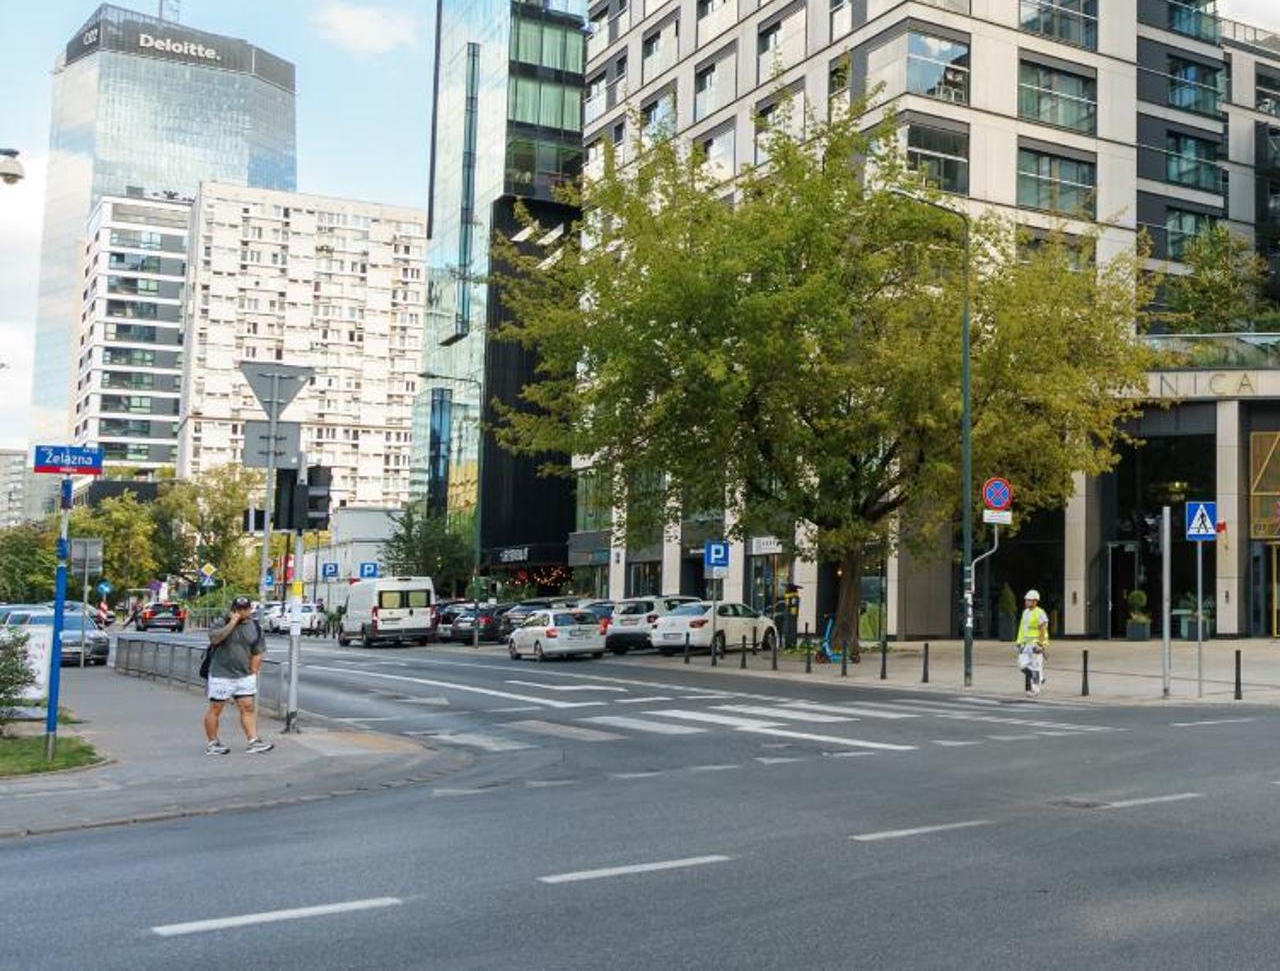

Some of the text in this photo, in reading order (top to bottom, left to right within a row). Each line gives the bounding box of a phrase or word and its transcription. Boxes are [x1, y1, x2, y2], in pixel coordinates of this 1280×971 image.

[139, 33, 222, 61] Deloitte.
[45, 449, 93, 466] Żelazna
[711, 544, 724, 563] P
[326, 564, 335, 576] P
[364, 564, 374, 578] P
